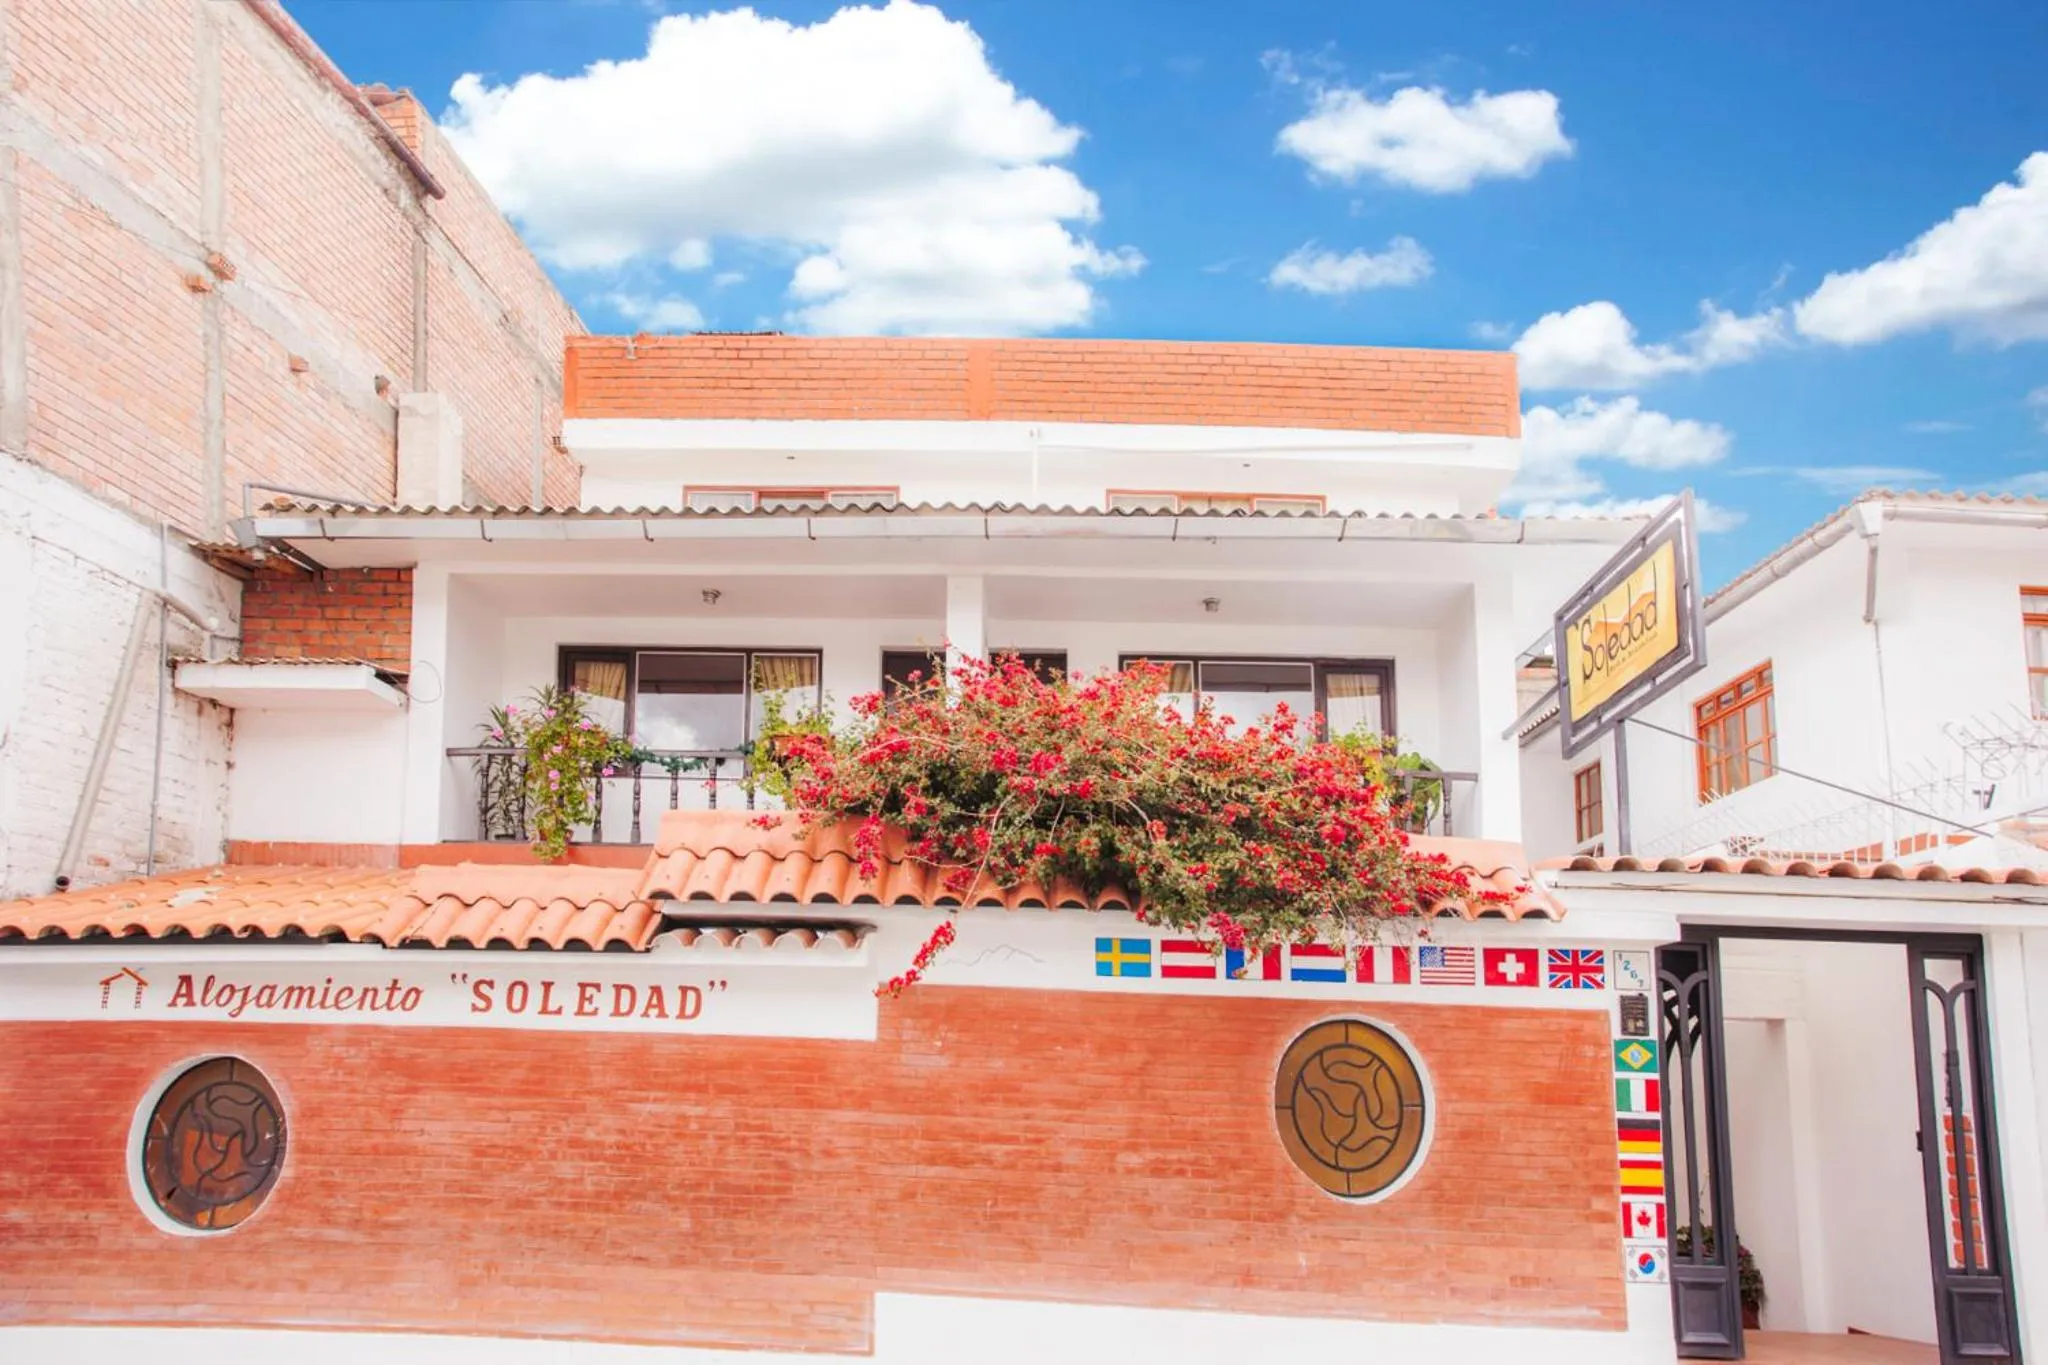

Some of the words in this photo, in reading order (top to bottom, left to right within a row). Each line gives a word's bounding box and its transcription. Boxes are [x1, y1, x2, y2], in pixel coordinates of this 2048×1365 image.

[1580, 559, 1657, 684] Soledad
[167, 974, 424, 1018] Alojamiento
[450, 972, 728, 1020] "SOLEDAD"
